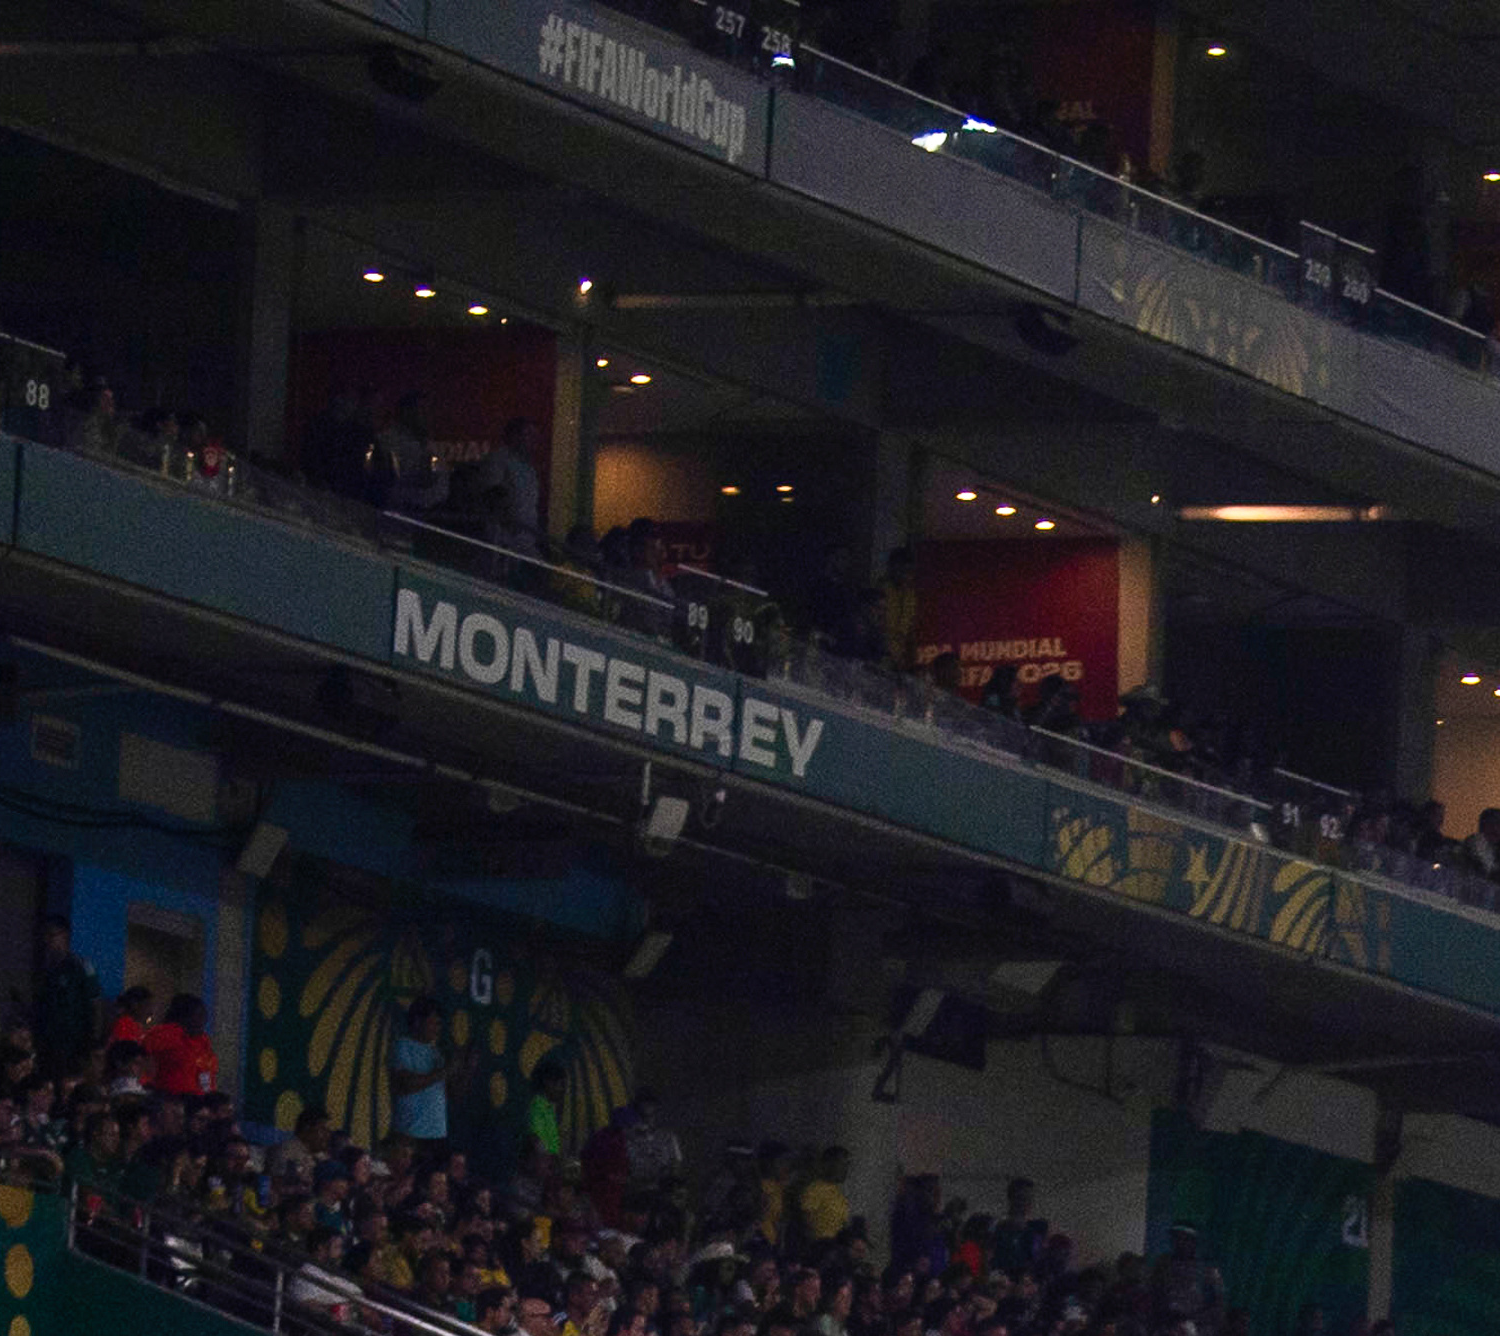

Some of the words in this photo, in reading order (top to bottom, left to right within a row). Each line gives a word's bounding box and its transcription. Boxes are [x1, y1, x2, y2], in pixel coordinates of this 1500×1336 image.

[538, 14, 747, 163] #FIFAWorldCup
[25, 380, 51, 410] 88
[733, 616, 755, 644] 90
[959, 636, 1067, 662] MUNDIAL
[392, 586, 825, 778] MONTERREY
